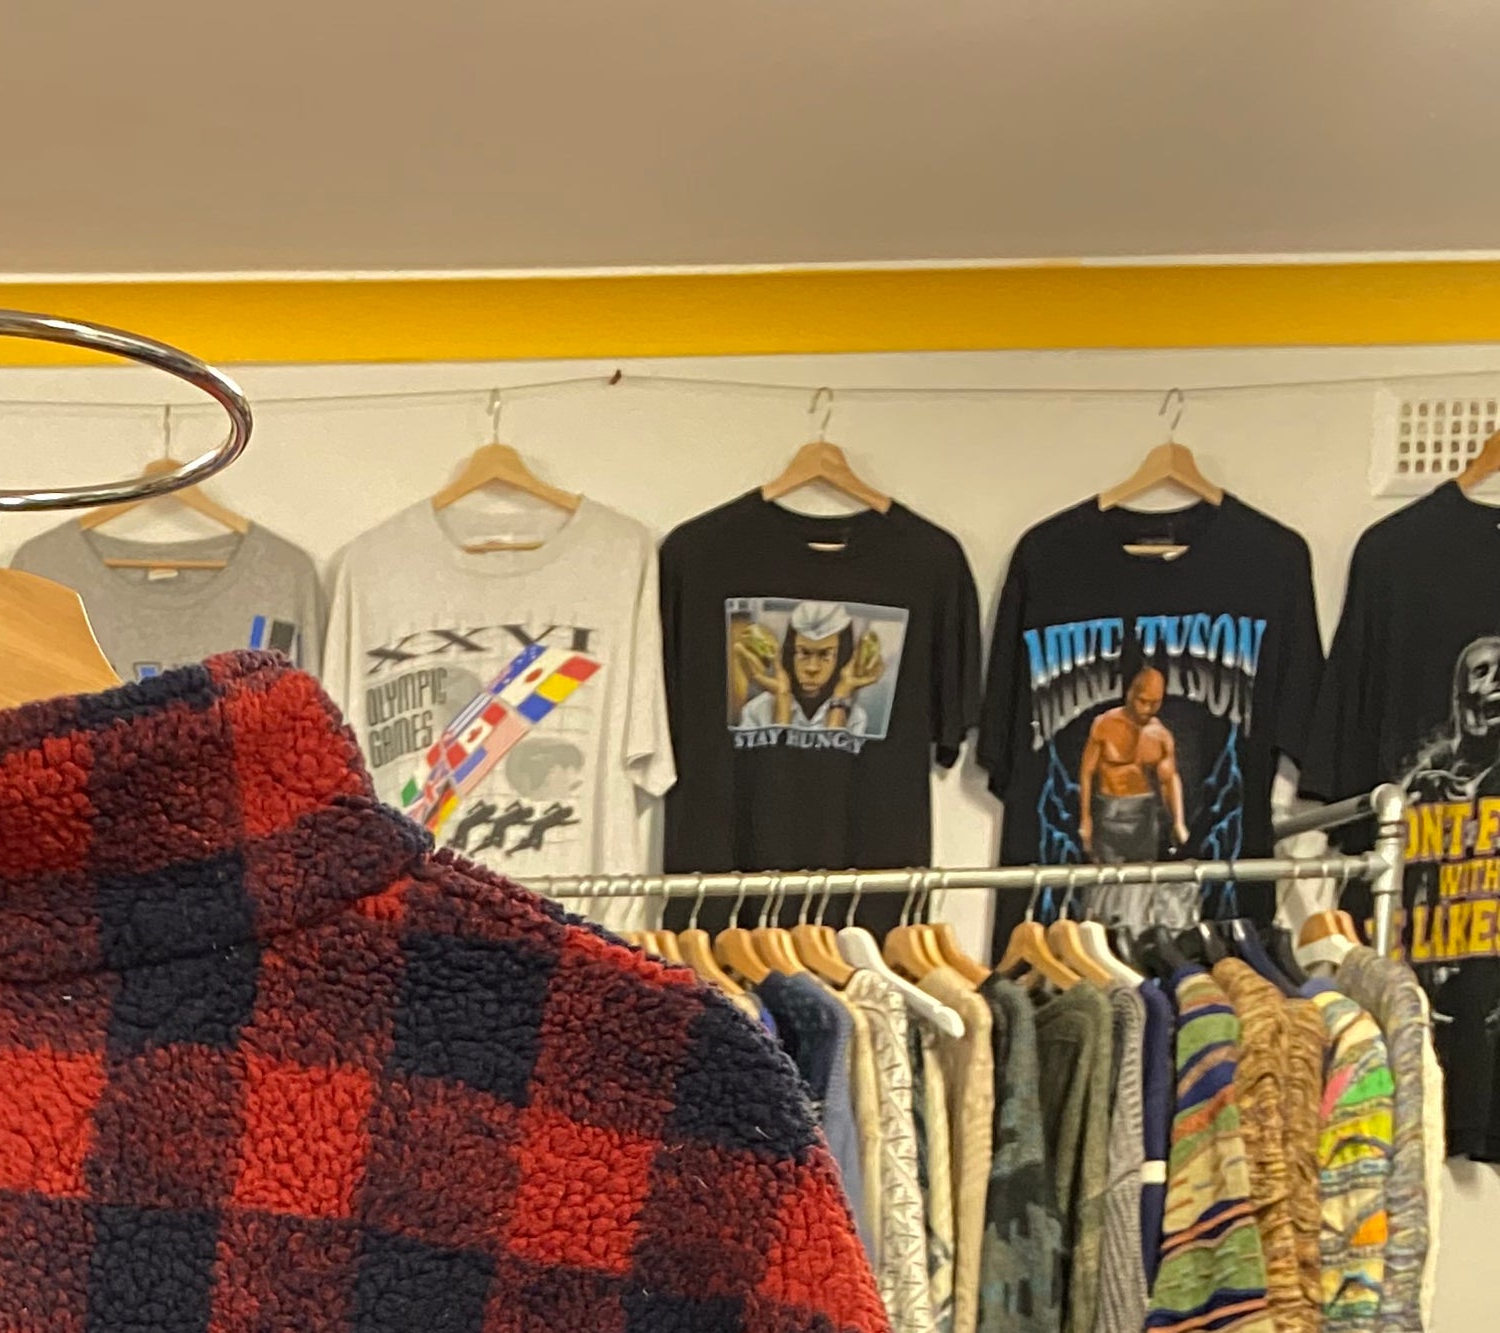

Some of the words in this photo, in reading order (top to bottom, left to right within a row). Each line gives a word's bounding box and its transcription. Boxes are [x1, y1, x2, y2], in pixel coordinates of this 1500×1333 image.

[365, 666, 449, 727] OLYMPIC
[1023, 617, 1126, 751] MIKE
[1134, 613, 1267, 738] TYSON
[368, 710, 434, 769] GAMES
[733, 729, 782, 748] STAY
[786, 730, 867, 754] HUNGY
[1410, 899, 1500, 964] LAKE
